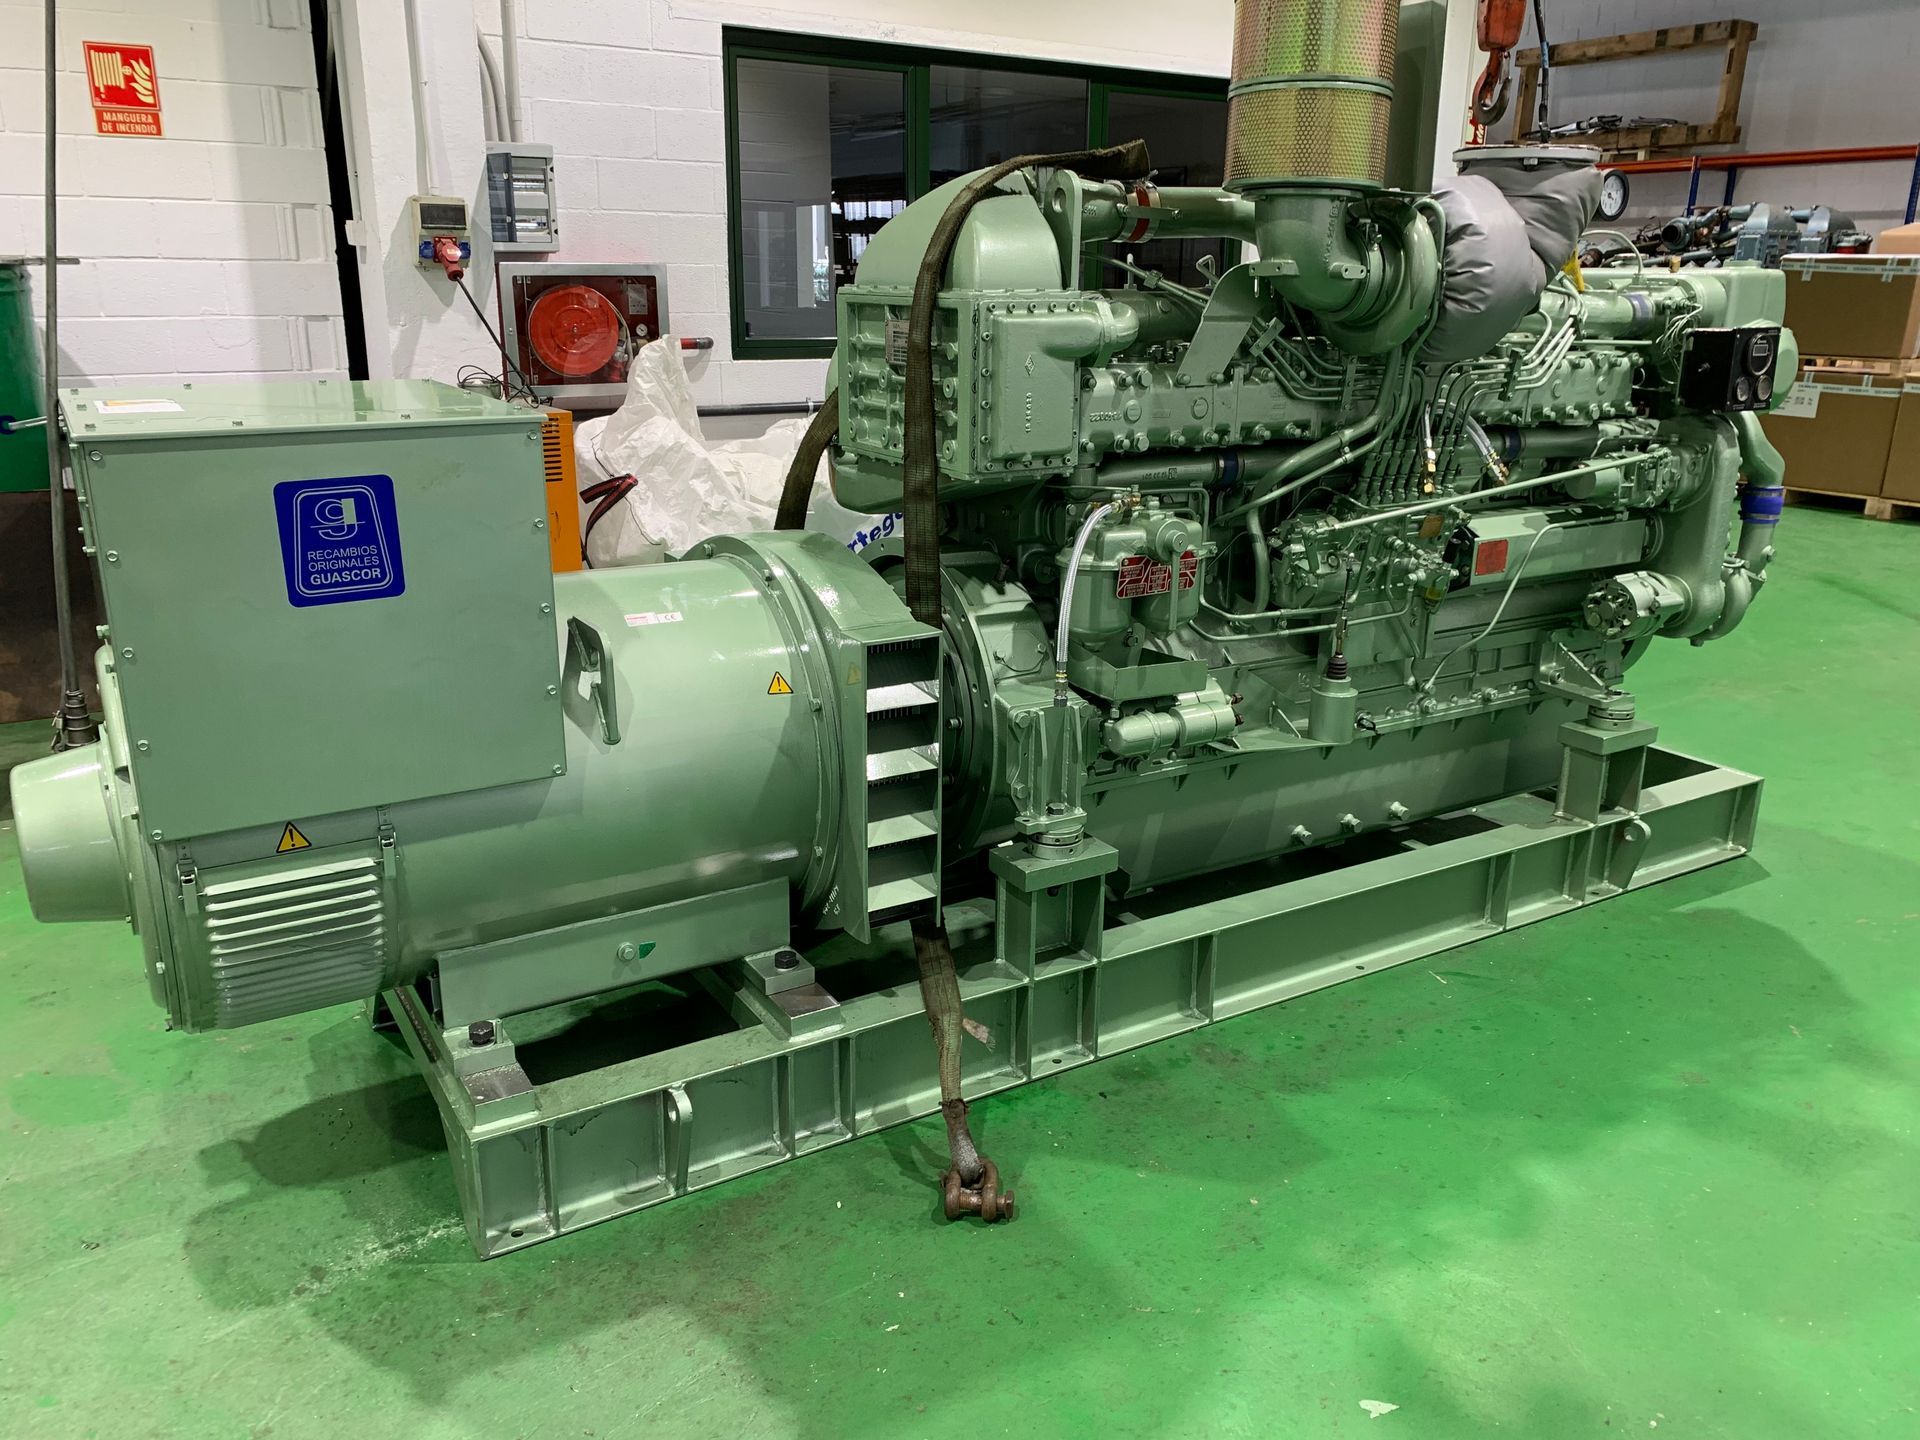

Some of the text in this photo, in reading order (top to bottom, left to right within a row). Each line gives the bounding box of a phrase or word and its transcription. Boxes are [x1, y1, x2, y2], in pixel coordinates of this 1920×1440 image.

[103, 111, 153, 123] MANGUERA
[102, 122, 158, 134] DE INCENDIO
[307, 545, 378, 561] RECAMBIOS
[308, 555, 380, 572] ORIGINALES
[310, 568, 381, 585] GUASCOR
